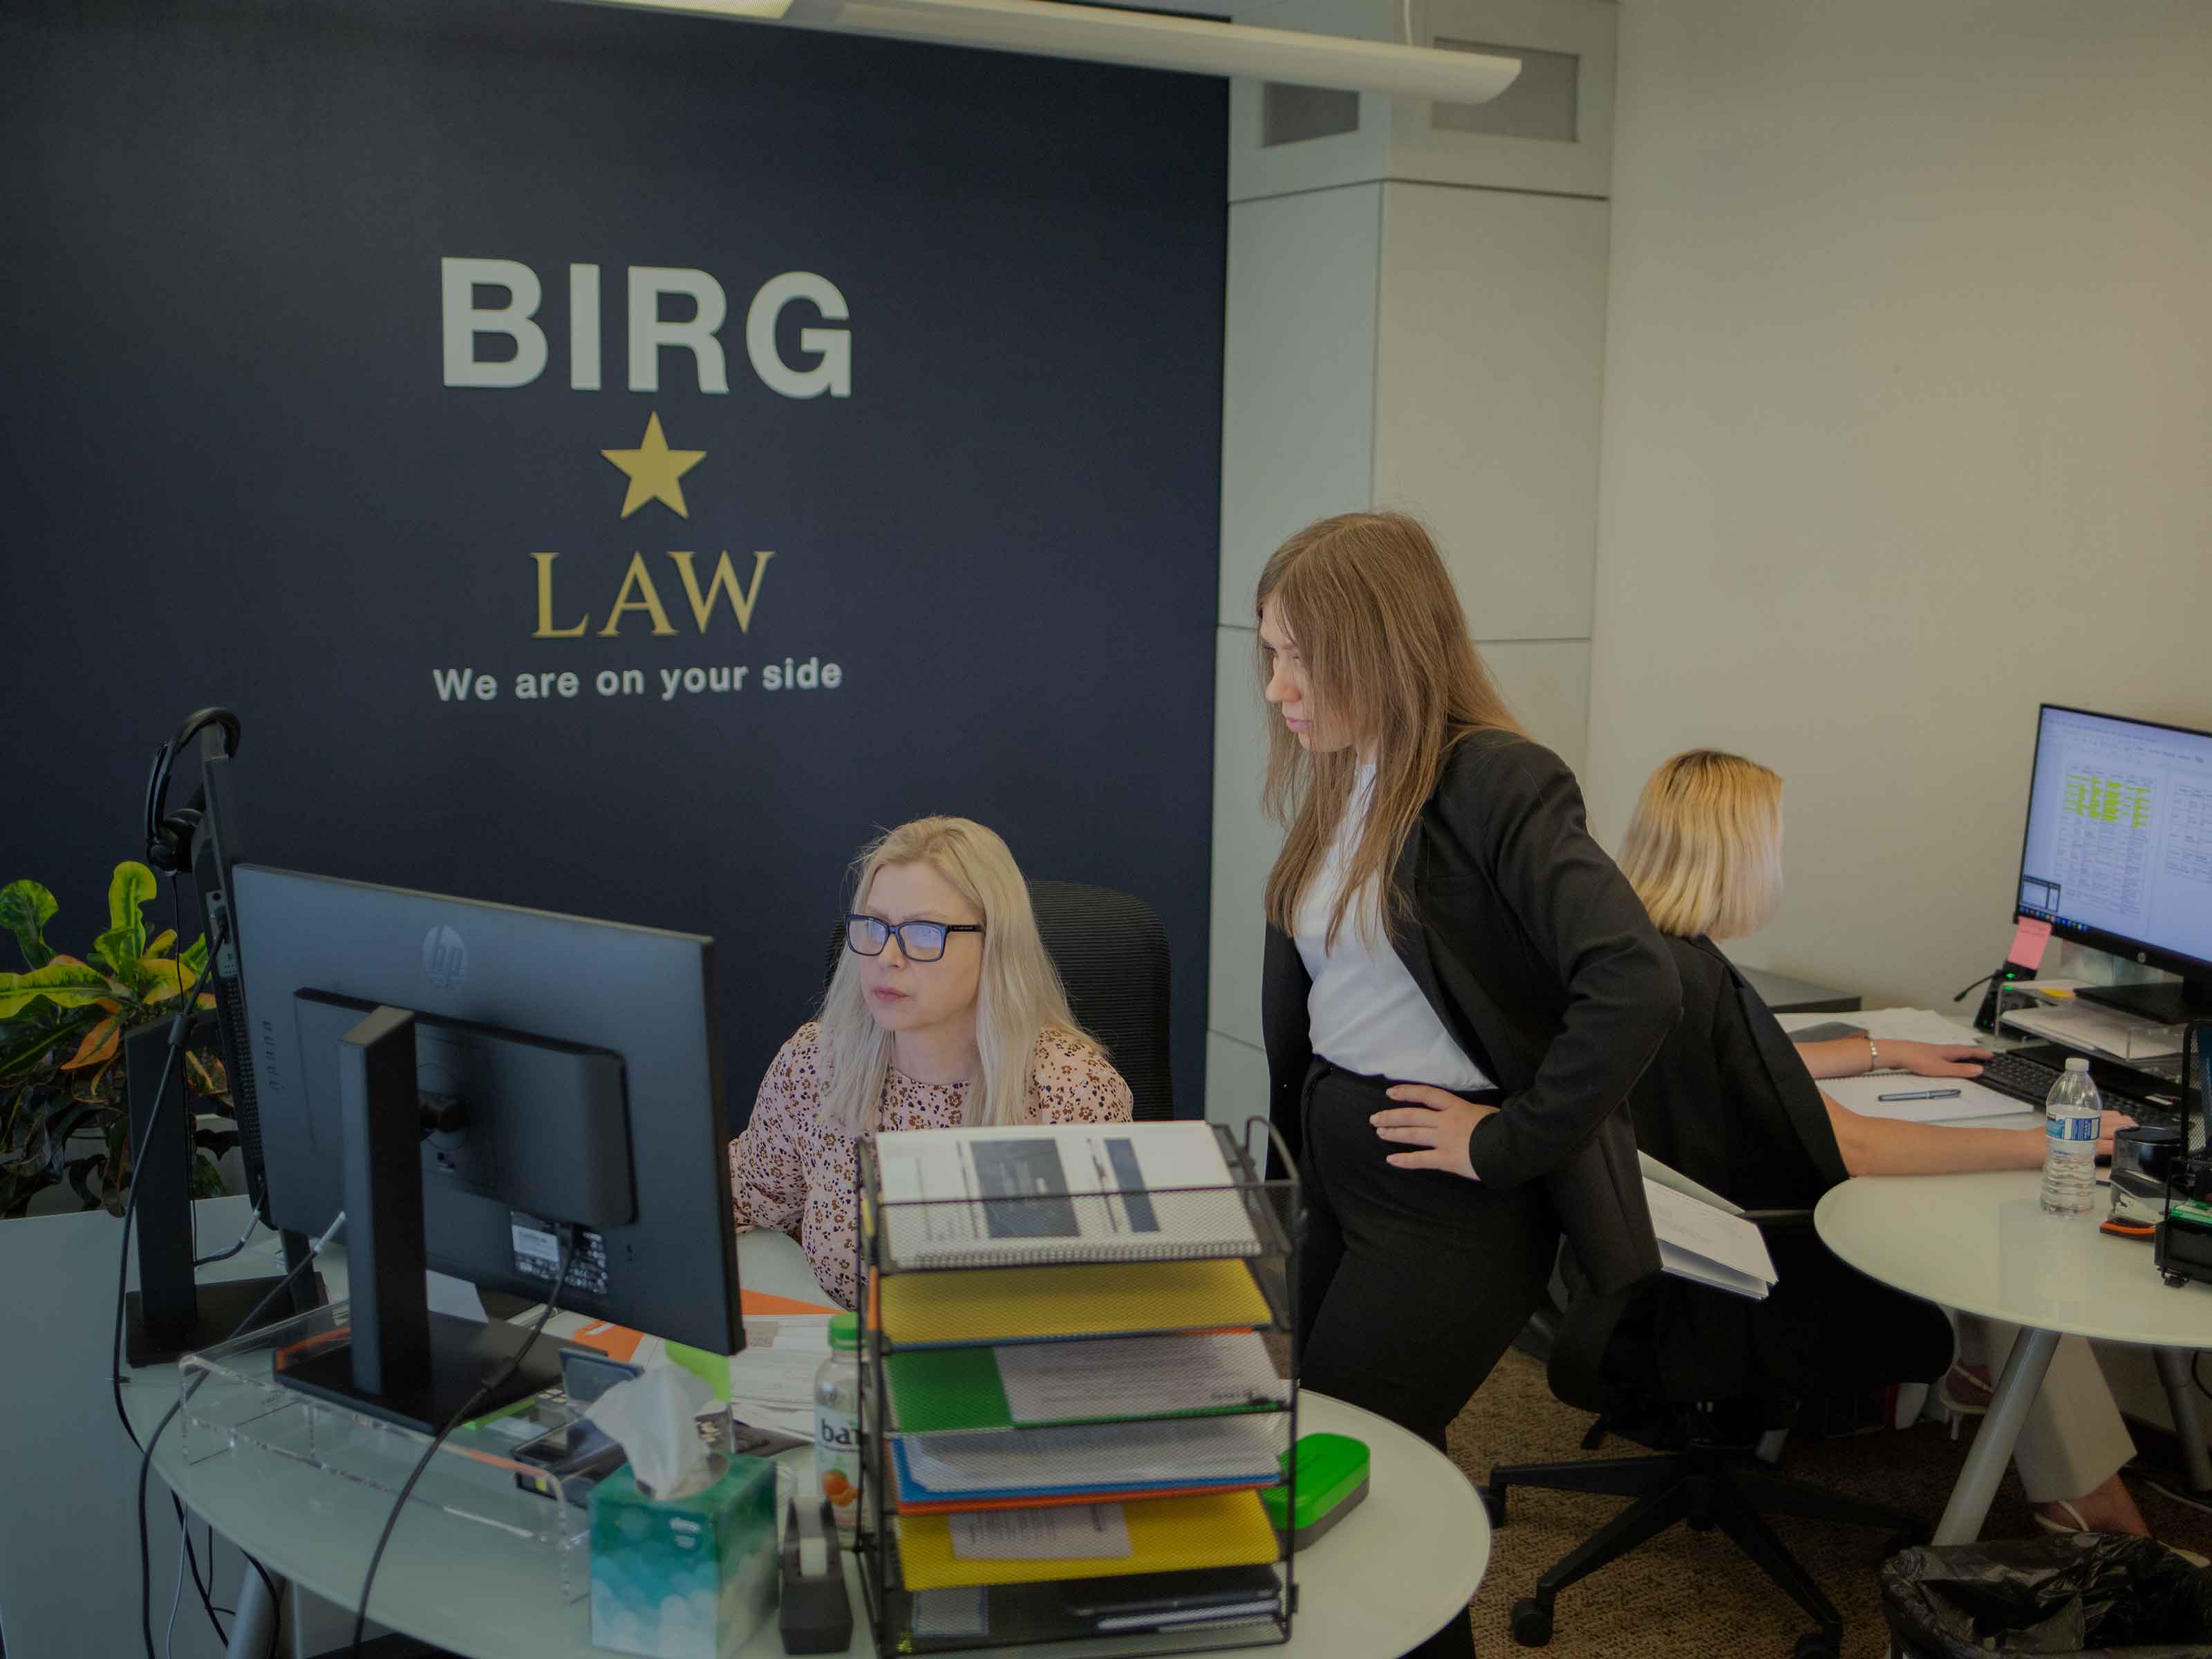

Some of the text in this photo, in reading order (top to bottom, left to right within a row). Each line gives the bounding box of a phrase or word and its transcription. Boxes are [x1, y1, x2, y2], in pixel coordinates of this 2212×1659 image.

[441, 256, 852, 400] BIRG
[529, 550, 776, 638] LAW
[433, 657, 843, 702] We are on your side
